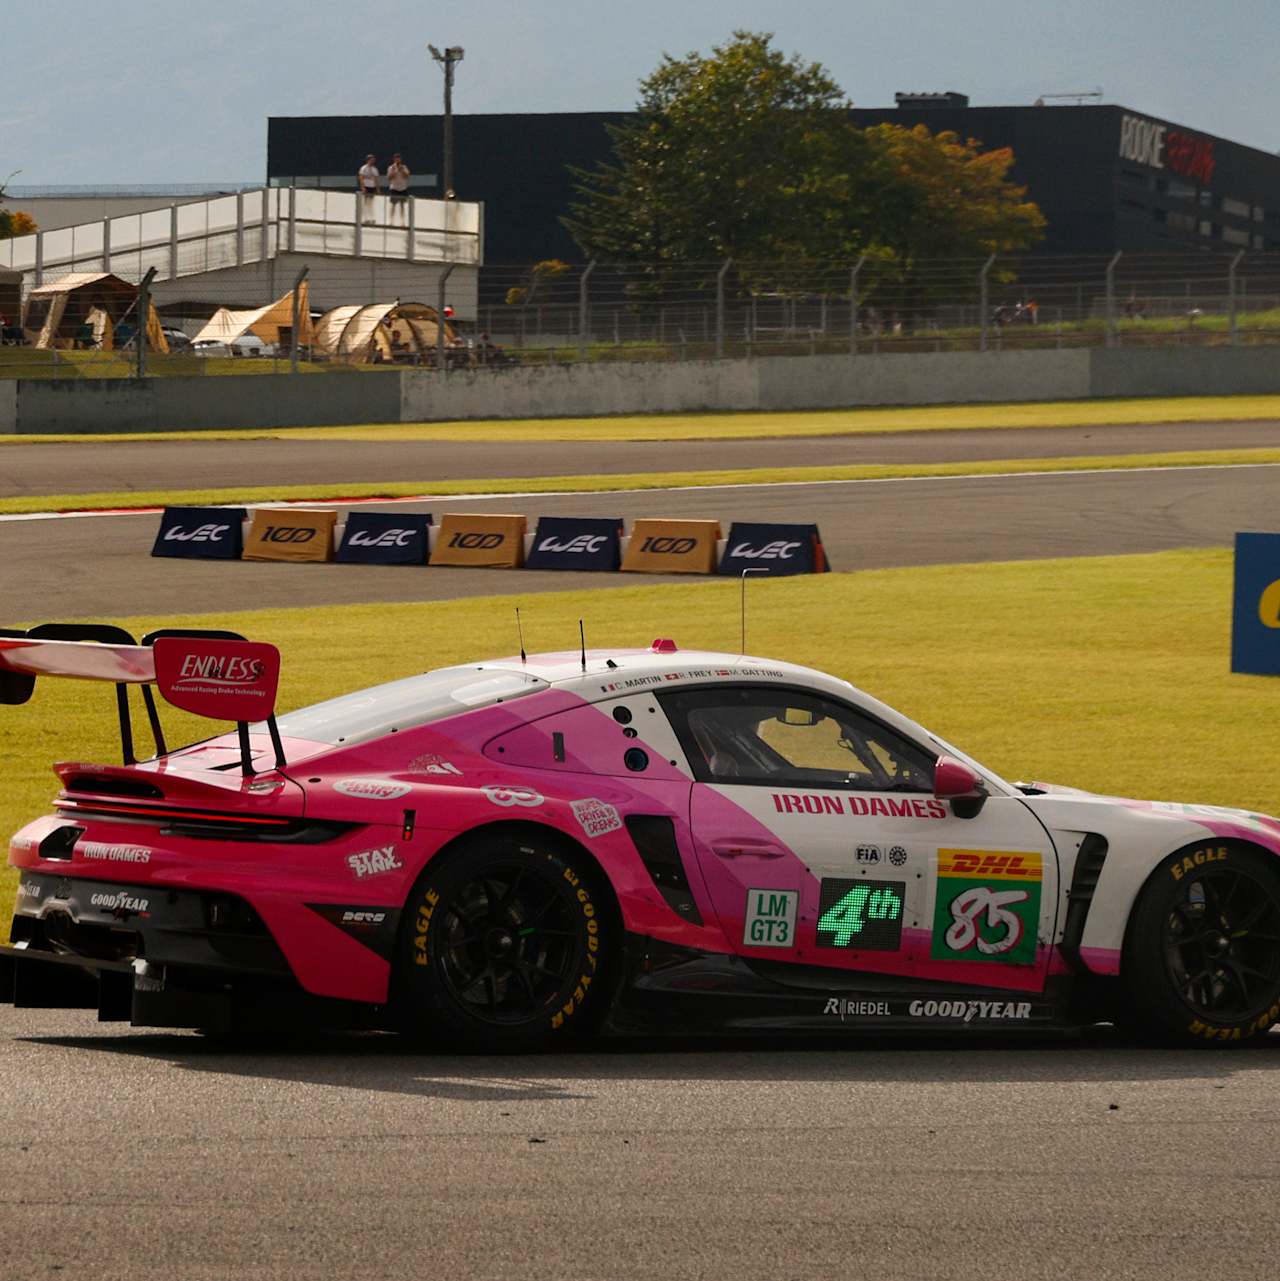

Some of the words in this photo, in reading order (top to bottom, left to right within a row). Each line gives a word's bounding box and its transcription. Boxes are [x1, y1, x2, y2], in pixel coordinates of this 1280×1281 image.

[164, 524, 230, 542] WEC
[348, 529, 417, 547] WEC
[538, 534, 608, 553] WEC
[730, 540, 802, 559] WEC
[180, 654, 261, 680] ENDLESS
[689, 670, 712, 679] FREY
[625, 675, 662, 688] MARTIN
[772, 794, 845, 815] IRON
[849, 797, 948, 819] DAMES
[109, 847, 152, 863] DAMES
[348, 846, 394, 866] STAY
[951, 854, 1028, 875] DHL
[1171, 847, 1229, 881] EAGLE
[756, 893, 788, 917] LM
[414, 888, 440, 966] EAGLE
[817, 885, 902, 948] 4th
[944, 886, 1030, 955] 85
[750, 919, 789, 943] GT3
[847, 1001, 891, 1016] RIEDEL
[909, 999, 1032, 1021] GOODYEAR
